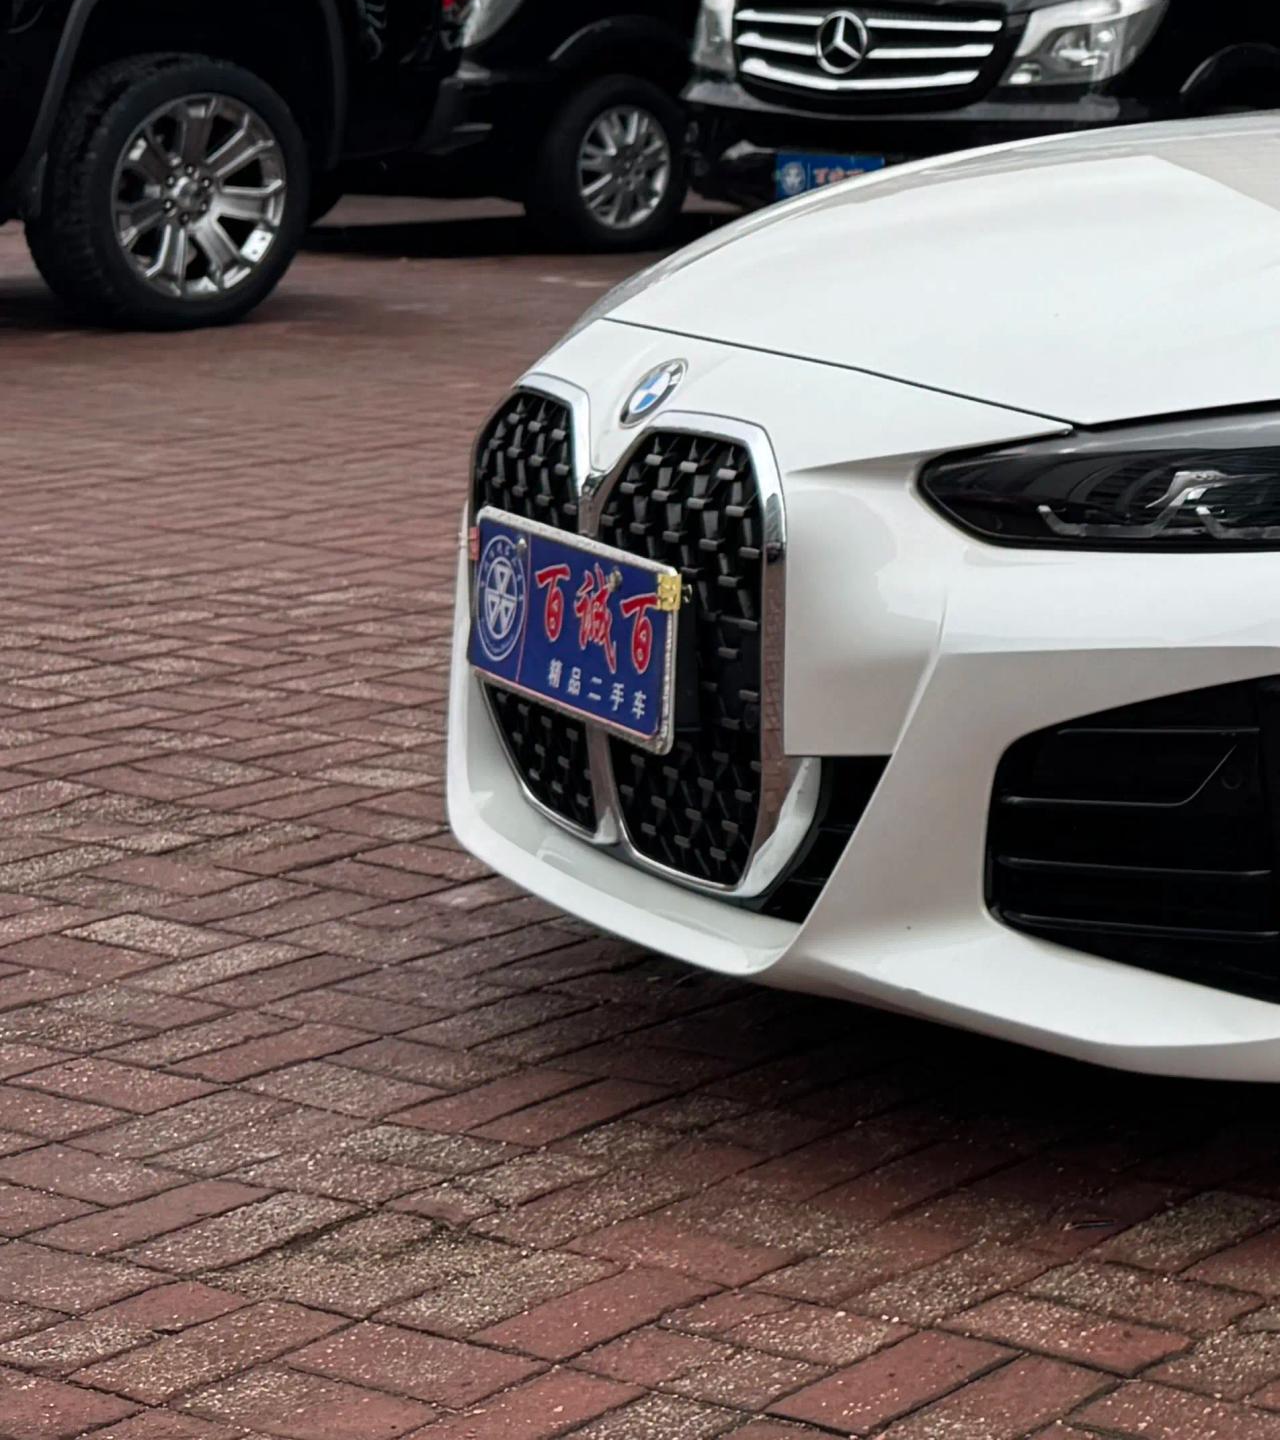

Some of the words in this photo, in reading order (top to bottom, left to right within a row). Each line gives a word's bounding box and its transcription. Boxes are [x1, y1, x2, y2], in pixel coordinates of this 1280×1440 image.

[548, 658, 648, 720] 精品二手车
